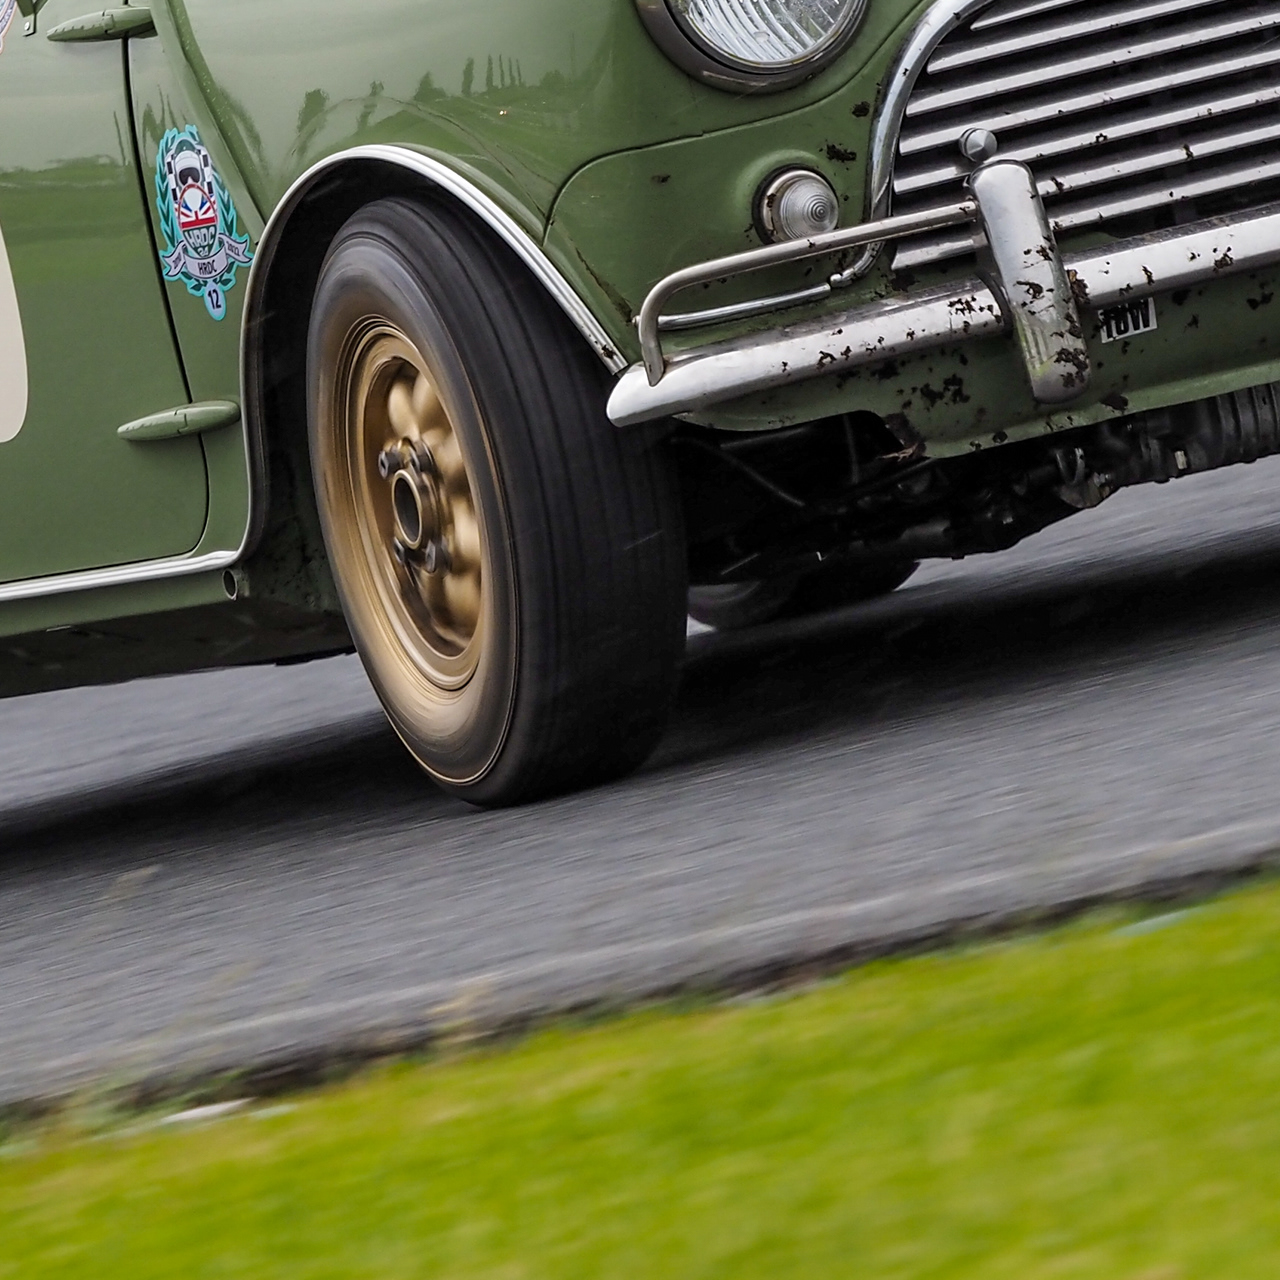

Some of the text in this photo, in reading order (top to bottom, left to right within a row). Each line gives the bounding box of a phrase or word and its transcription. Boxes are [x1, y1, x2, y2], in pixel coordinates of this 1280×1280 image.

[184, 226, 215, 248] HRDC
[197, 260, 217, 275] HRDC
[207, 289, 222, 310] 12
